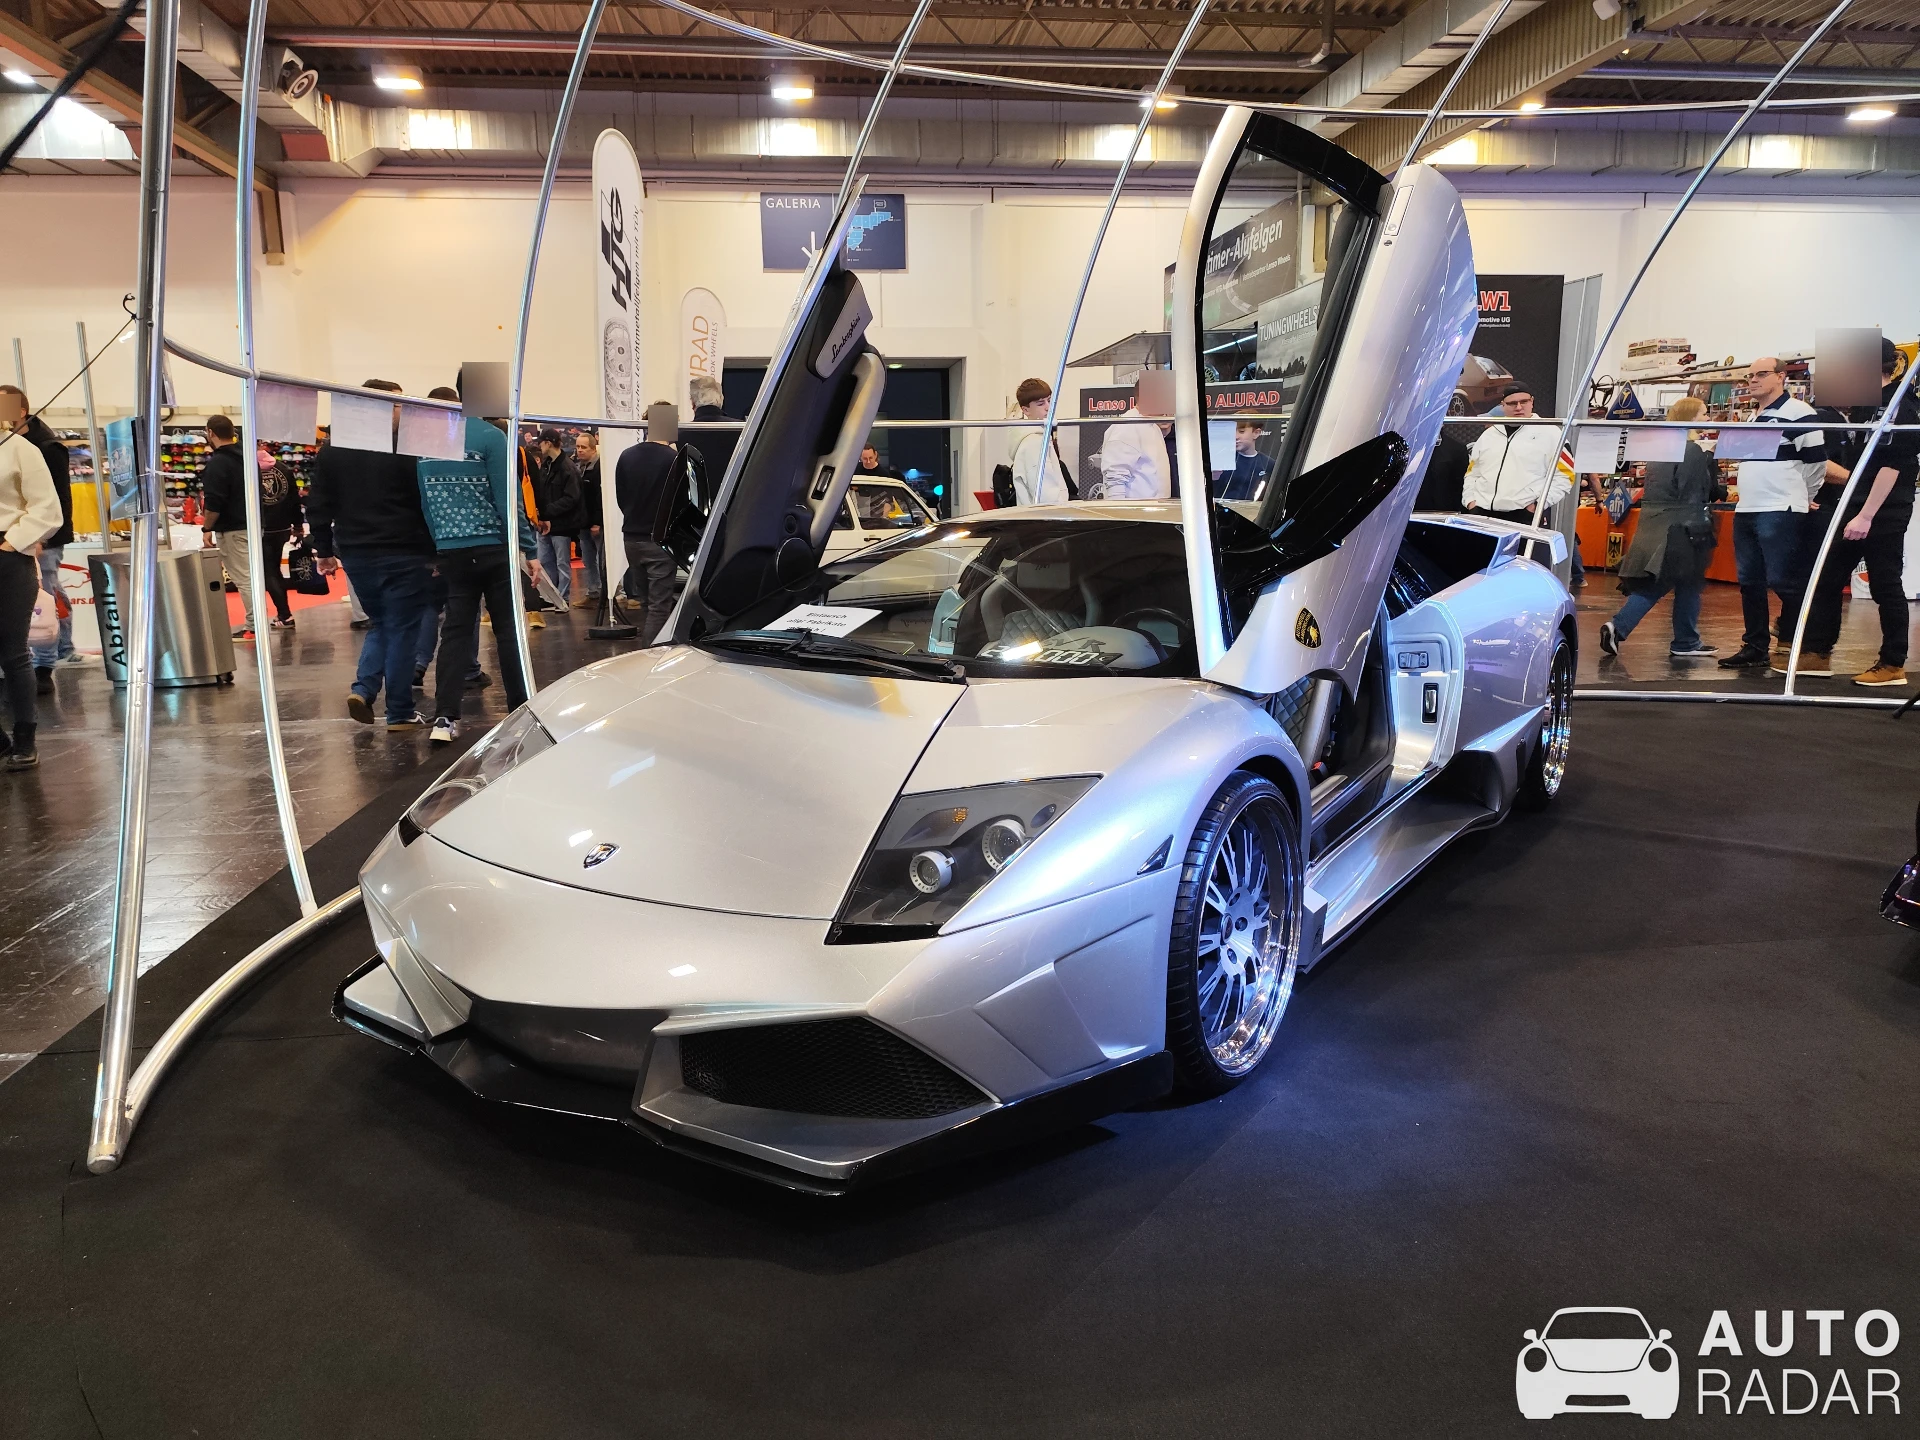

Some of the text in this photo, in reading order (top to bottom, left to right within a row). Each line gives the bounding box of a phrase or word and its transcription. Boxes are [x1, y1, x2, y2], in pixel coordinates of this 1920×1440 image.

[765, 197, 821, 209] GALERIA
[605, 187, 631, 313] HTG
[1205, 219, 1283, 276] timer-Alufelgen
[1478, 291, 1511, 311] W1
[1259, 304, 1318, 342] TUNINGWHEELS
[711, 322, 719, 358] WHEELS
[1089, 397, 1127, 411] Lenso
[1215, 391, 1280, 408] ALURAD
[1609, 497, 1625, 513] afri
[102, 593, 127, 667] Abfall
